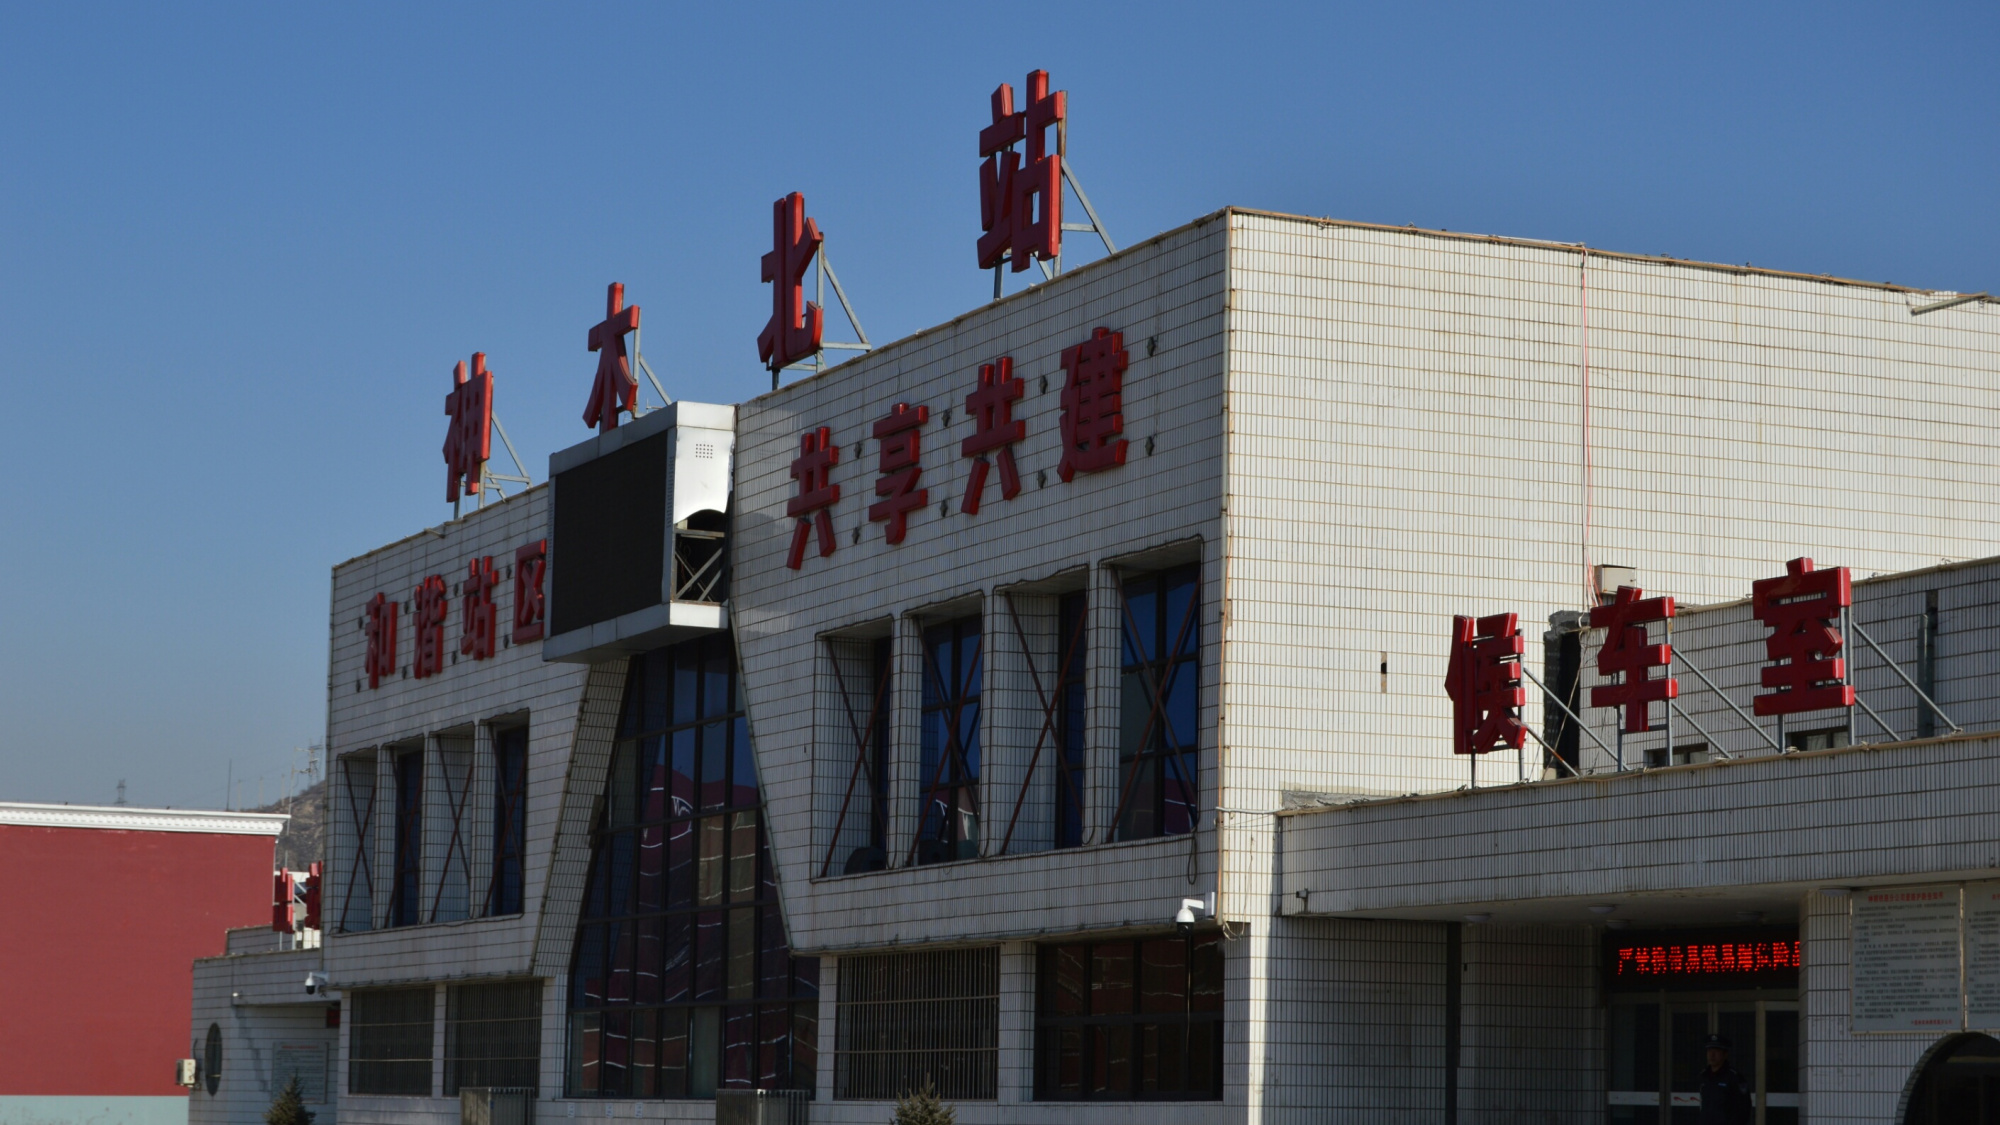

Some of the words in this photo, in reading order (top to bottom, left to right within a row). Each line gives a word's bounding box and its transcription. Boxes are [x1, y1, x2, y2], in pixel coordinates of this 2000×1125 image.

[442, 69, 1065, 503] 神木北站
[786, 326, 1130, 571] 共享共建
[364, 538, 547, 690] 和谐站区
[1444, 556, 1855, 755] 候车室
